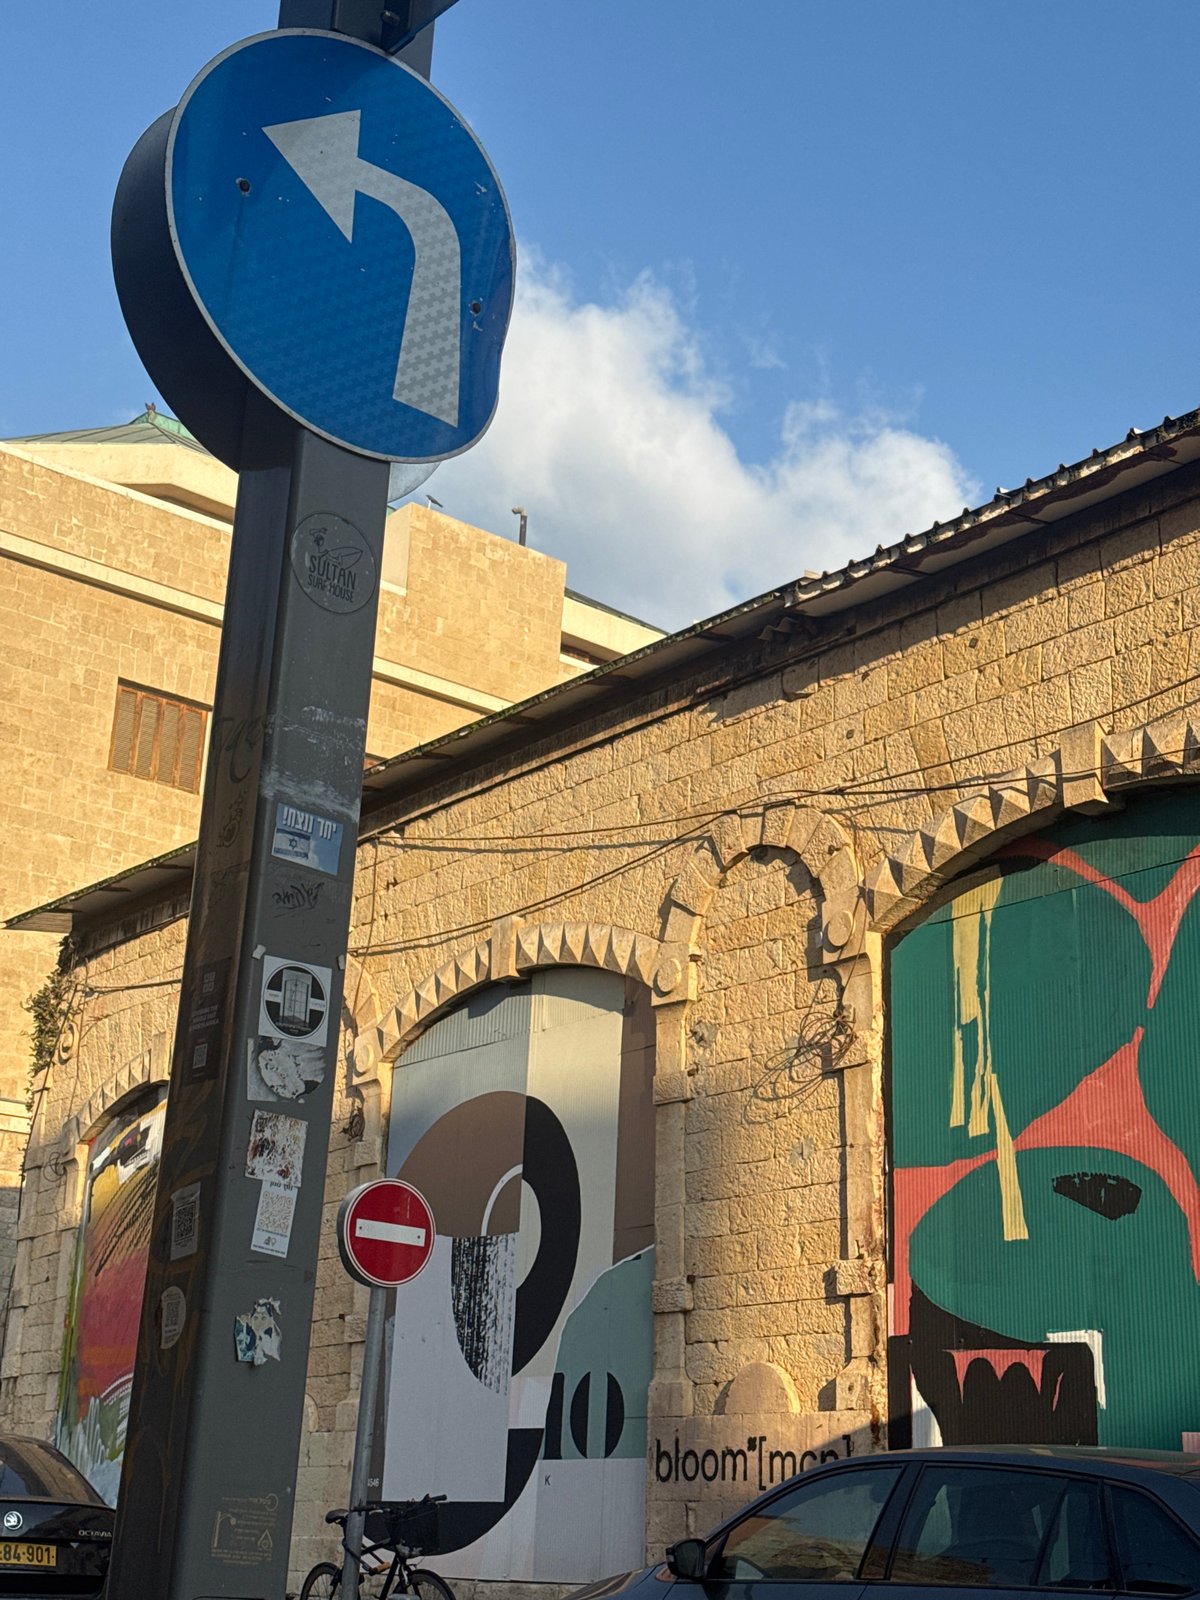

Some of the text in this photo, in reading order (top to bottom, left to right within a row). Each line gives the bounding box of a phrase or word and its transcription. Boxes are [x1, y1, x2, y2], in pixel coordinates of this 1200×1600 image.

[308, 555, 357, 590] SULTAN
[329, 582, 354, 603] HOUSE
[283, 807, 338, 840] יחד ננצח!
[544, 1474, 551, 1486] K
[79, 1529, 112, 1538] OCTAVIA
